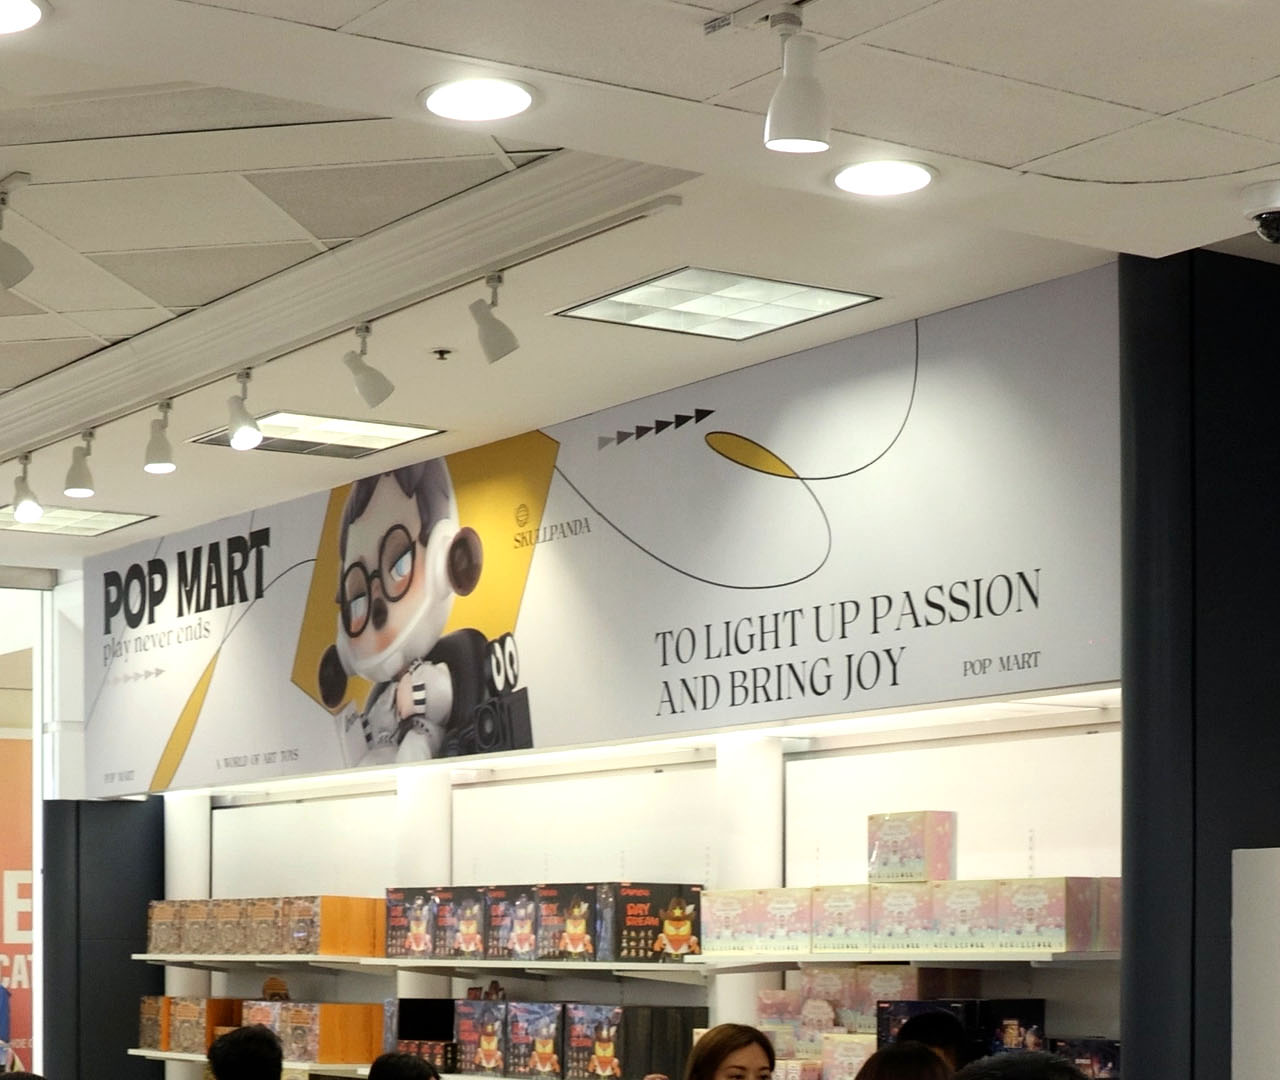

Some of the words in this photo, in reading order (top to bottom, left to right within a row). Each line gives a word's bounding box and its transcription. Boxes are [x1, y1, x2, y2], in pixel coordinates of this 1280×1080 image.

[514, 517, 592, 549] SKULLPANDA
[103, 558, 168, 635] POP
[176, 527, 270, 618] MART
[103, 636, 132, 666] play
[135, 630, 173, 653] never
[177, 617, 210, 644] ends
[655, 627, 696, 667] TO
[704, 608, 803, 660] LIGHT
[813, 599, 860, 643] UP
[870, 569, 1041, 635] PASSION
[656, 674, 720, 716] AND
[729, 657, 832, 707] BRING
[842, 646, 907, 701] JOY
[963, 658, 992, 677] POP
[998, 651, 1041, 672] MART
